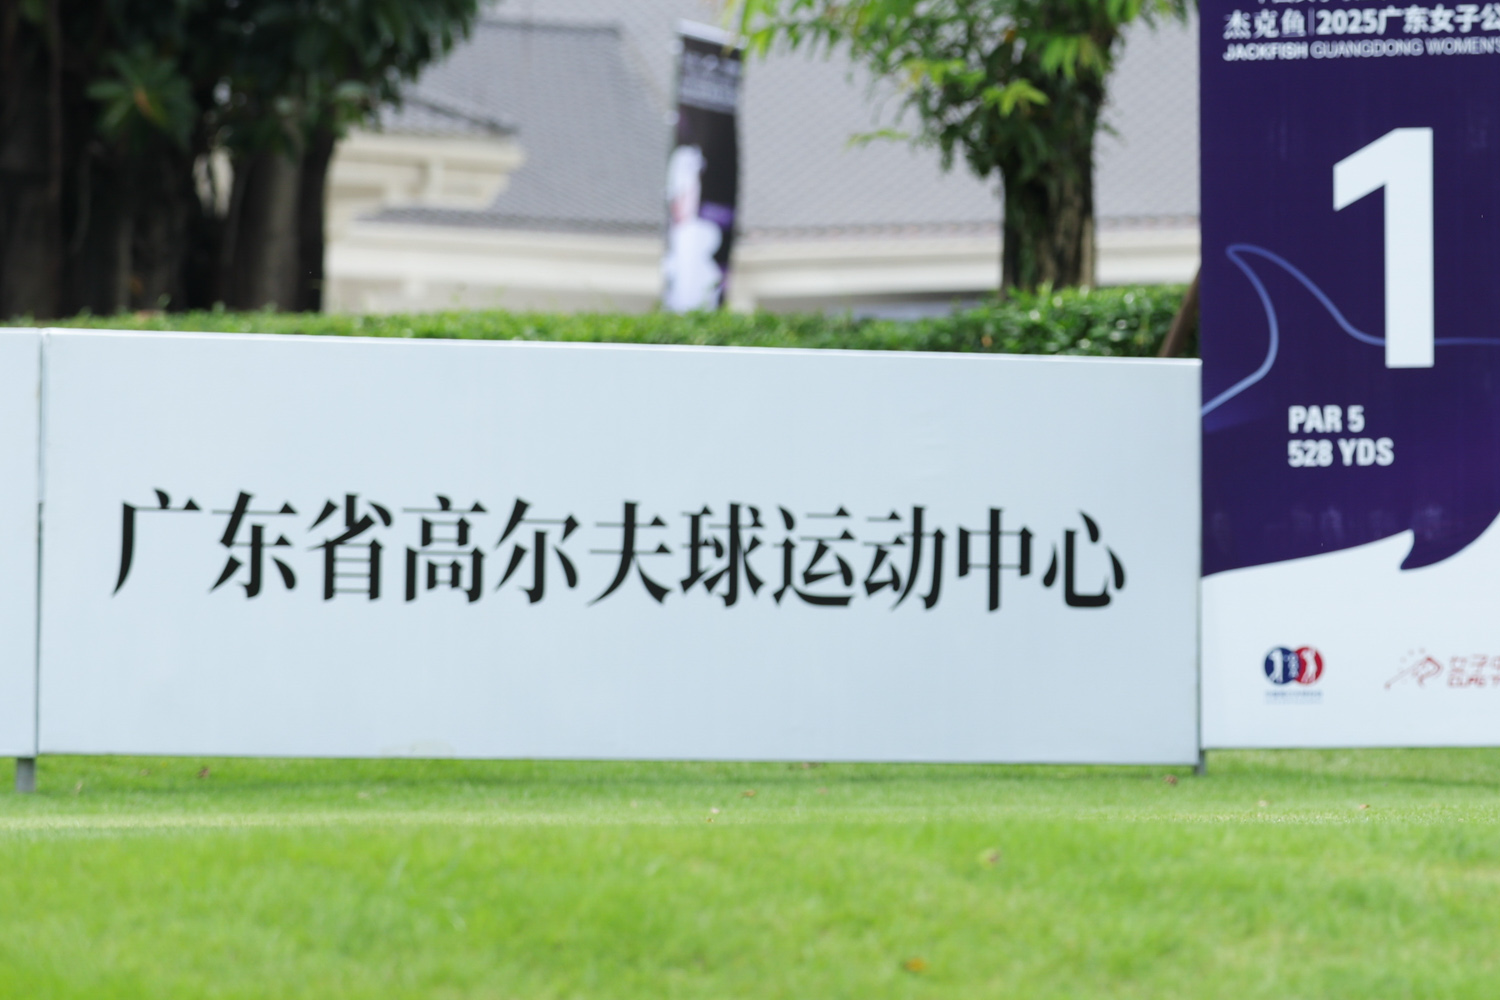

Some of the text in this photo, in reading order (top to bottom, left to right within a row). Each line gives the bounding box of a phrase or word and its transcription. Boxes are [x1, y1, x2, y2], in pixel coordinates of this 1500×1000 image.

[1223, 8, 1307, 40] 杰克鱼
[1223, 42, 1309, 61] JACKFISH
[1310, 38, 1424, 59] GUANGDONG
[1333, 127, 1434, 368] 1
[1288, 405, 1365, 433] PAR 5
[1288, 437, 1395, 467] 528 YDS
[113, 488, 1126, 613] 广东省高尔夫球运动中心
